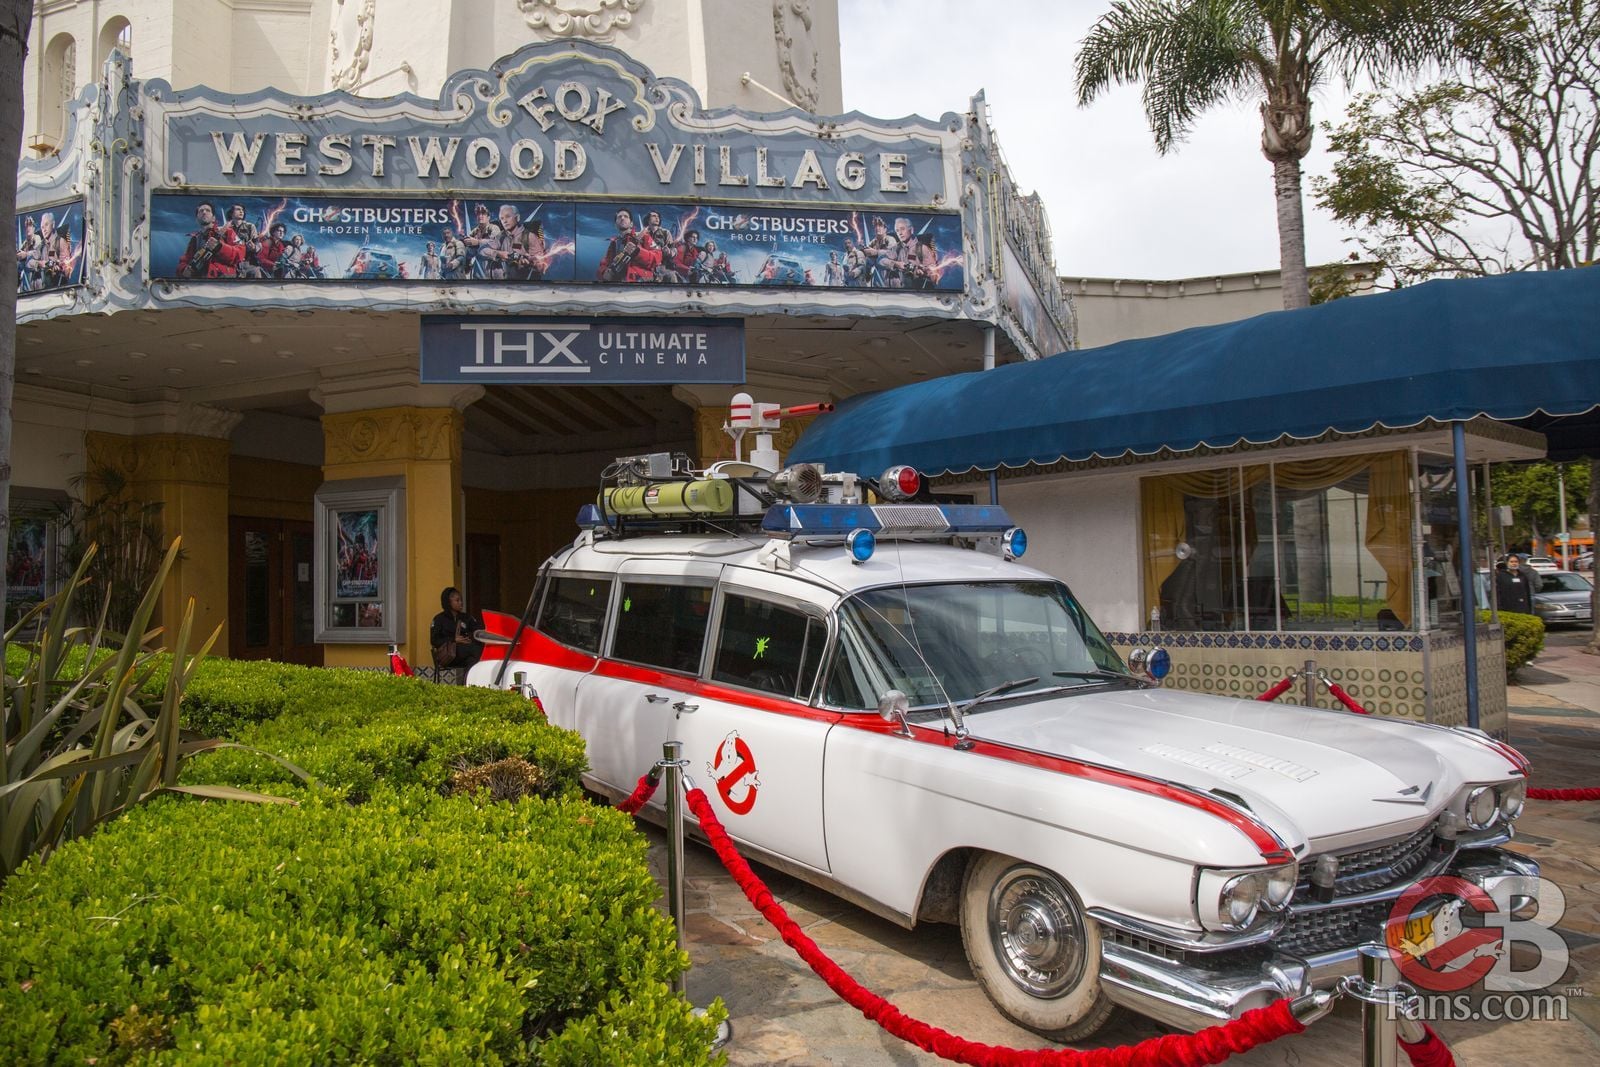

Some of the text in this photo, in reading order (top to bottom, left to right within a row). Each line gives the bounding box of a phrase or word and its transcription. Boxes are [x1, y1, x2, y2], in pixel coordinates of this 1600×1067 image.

[517, 81, 627, 135] FOX
[209, 130, 910, 194] WESTWOOD VILLAGE
[319, 225, 423, 235] FROZEN EMPIRE
[730, 233, 826, 244] FROZEN EMPIRE
[459, 323, 591, 365] THX
[598, 332, 708, 350] ULTIMATE
[598, 352, 708, 365] CINEMA
